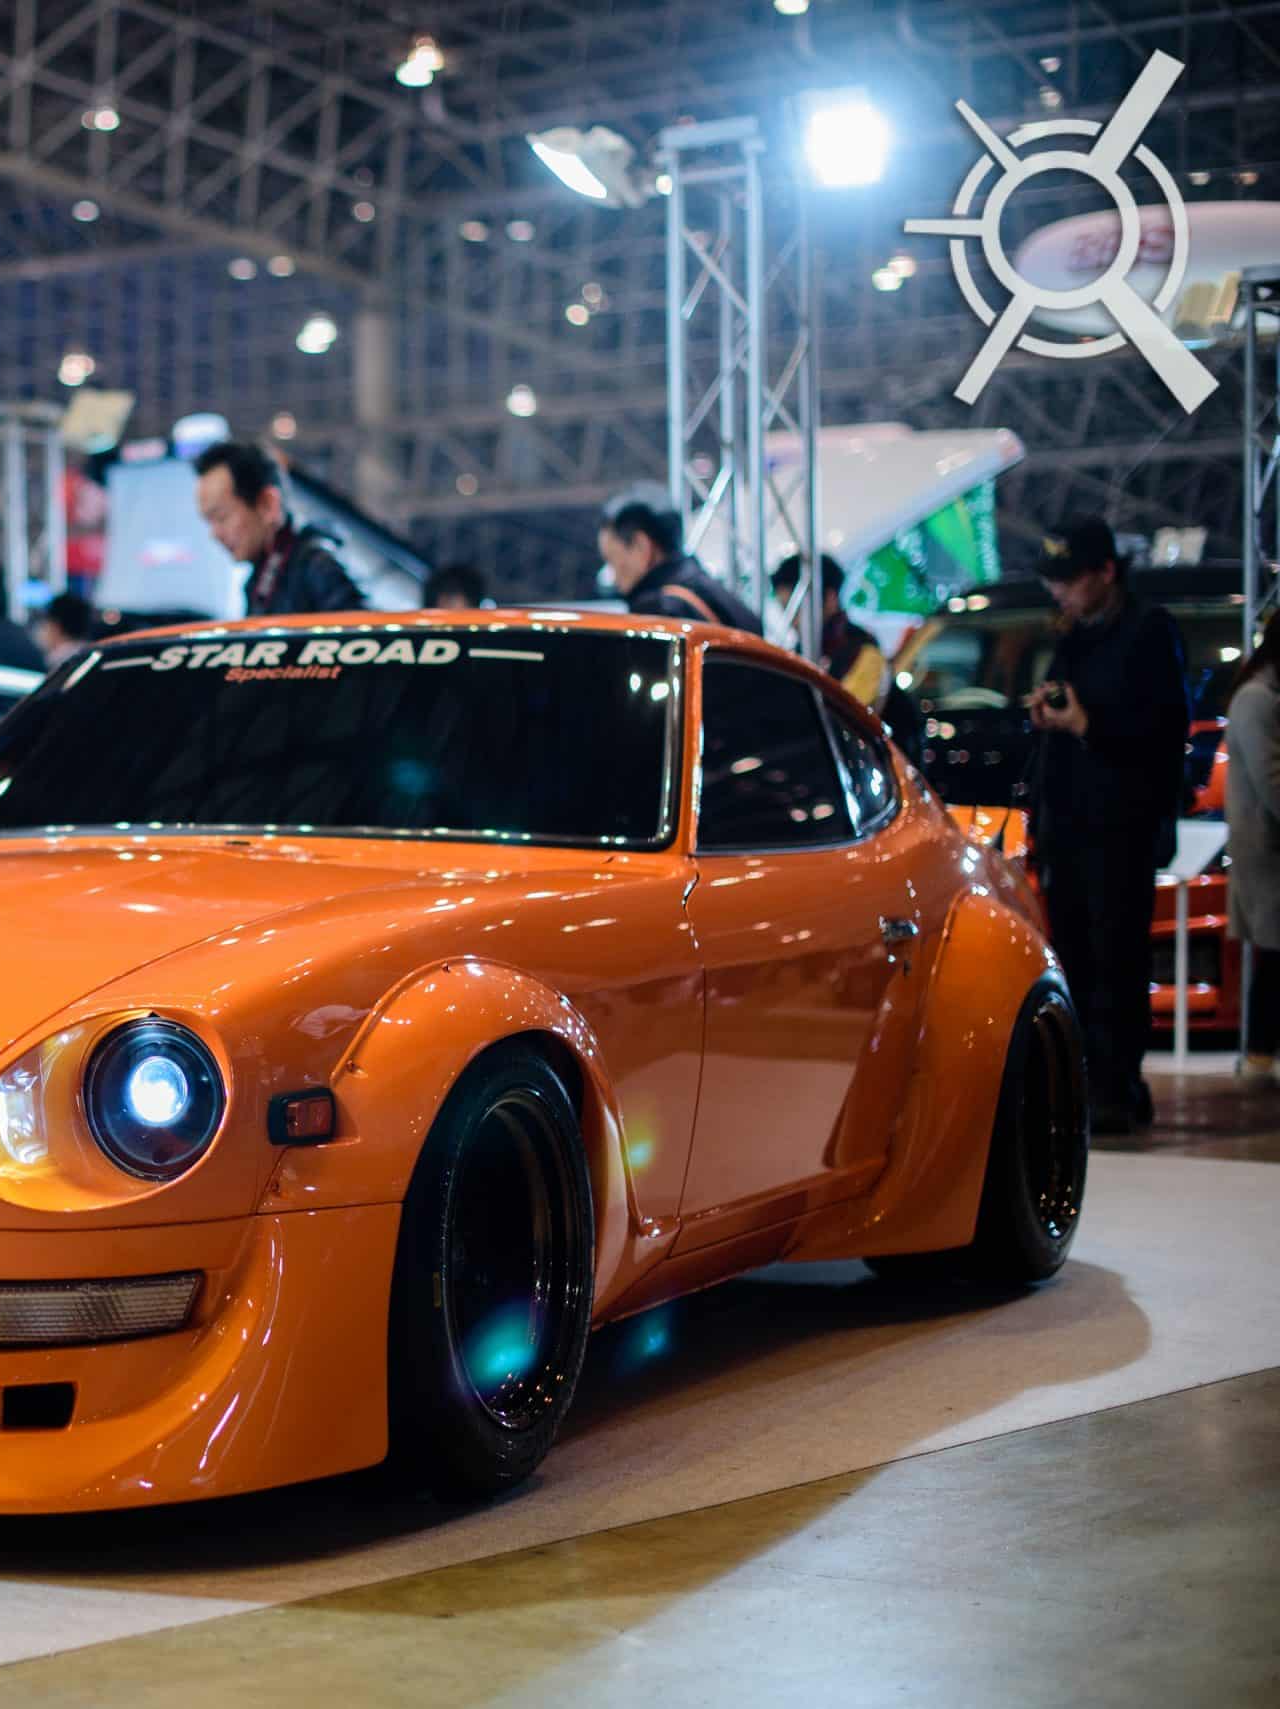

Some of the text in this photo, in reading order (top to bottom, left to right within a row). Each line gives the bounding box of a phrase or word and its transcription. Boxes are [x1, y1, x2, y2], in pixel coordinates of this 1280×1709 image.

[150, 639, 461, 671] STAR ROAD
[225, 665, 342, 683] Specialist
